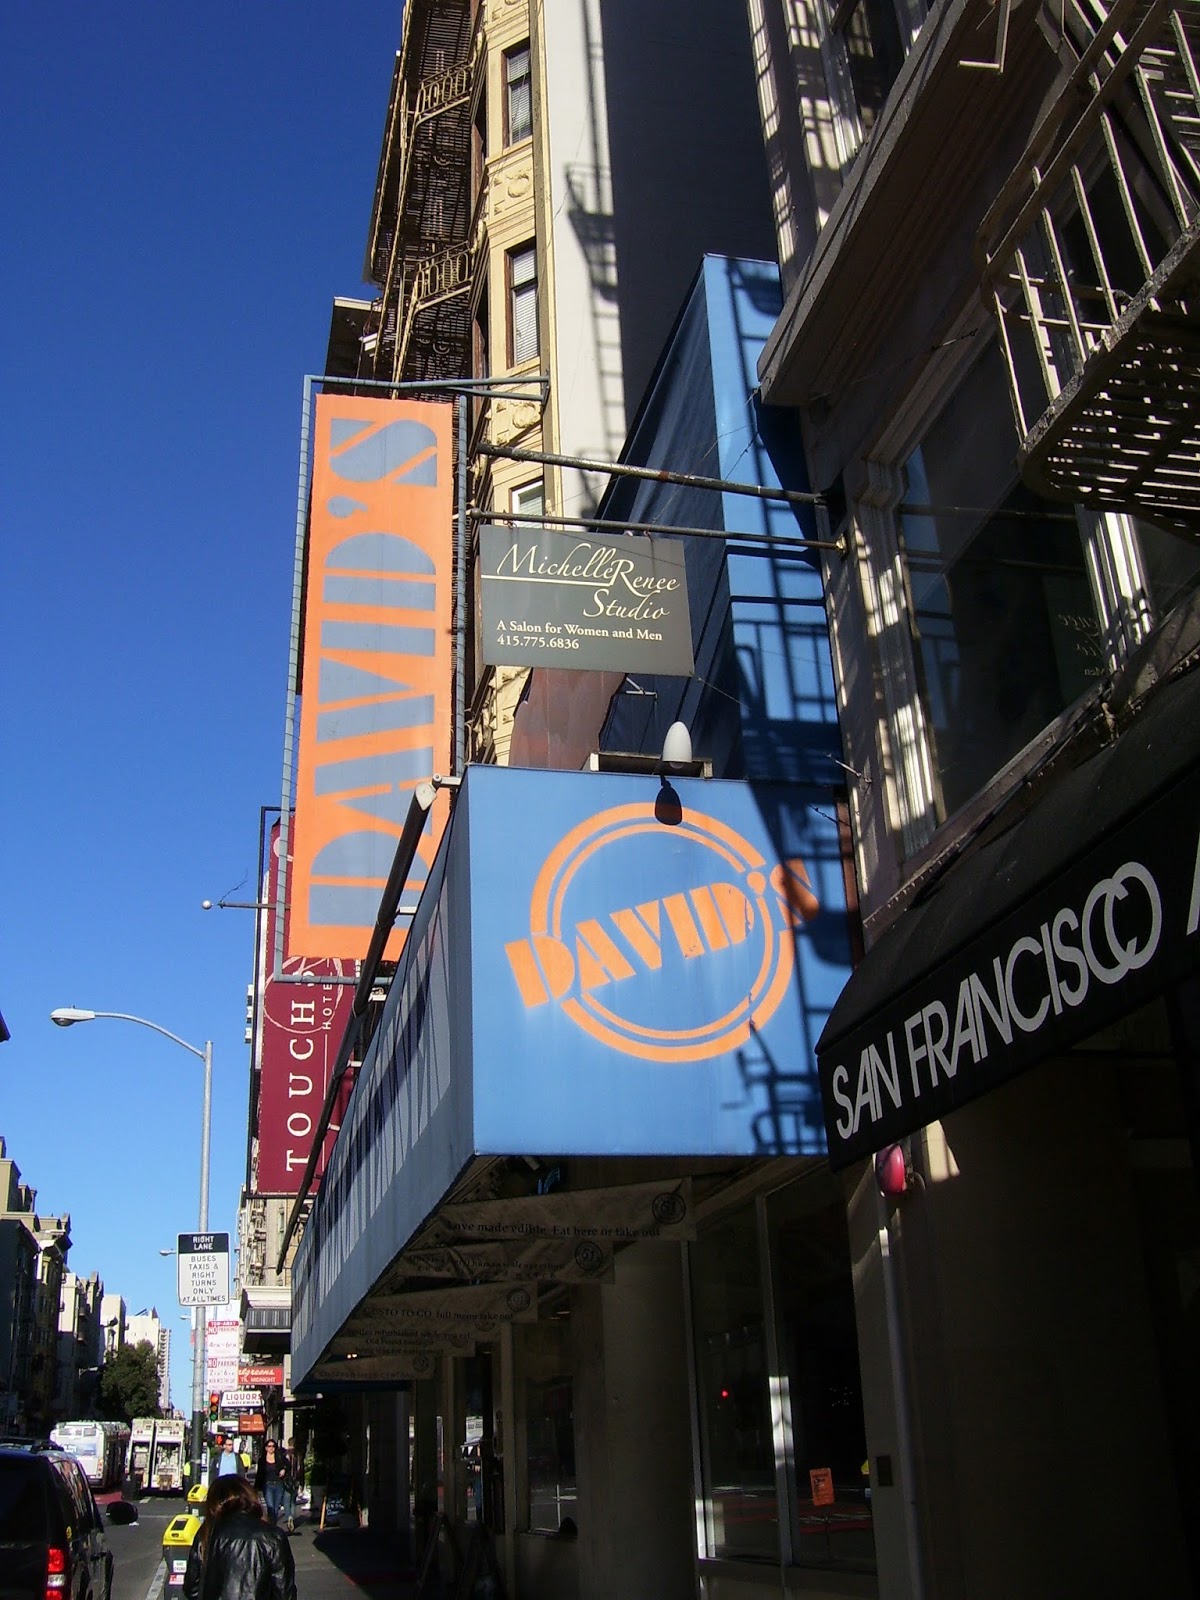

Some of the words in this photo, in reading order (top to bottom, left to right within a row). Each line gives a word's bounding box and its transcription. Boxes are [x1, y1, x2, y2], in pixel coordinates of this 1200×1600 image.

[583, 588, 671, 621] Studio
[496, 620, 507, 631] A
[509, 620, 542, 634] Salon
[545, 622, 562, 635] for
[563, 624, 609, 638] Women
[612, 628, 634, 640] and
[636, 629, 663, 641] Men
[496, 634, 580, 650] 415.775.6836
[308, 418, 438, 927] DAVID'S
[503, 858, 819, 1010] DAVID'S
[832, 1031, 902, 1140] SAN
[904, 861, 1162, 1098] FRANCISCO
[477, 1222, 508, 1233] made
[553, 1224, 570, 1236] Eat
[573, 1225, 597, 1237] here
[600, 1229, 612, 1237] or
[615, 1226, 637, 1238] take
[640, 1228, 660, 1238] out
[192, 1235, 215, 1244] RIGHT
[401, 1308, 415, 1318] TO
[416, 1309, 432, 1319] GO
[209, 1326, 217, 1334] NO
[208, 1358, 217, 1368] NO
[225, 1393, 263, 1401] LIQUORS
